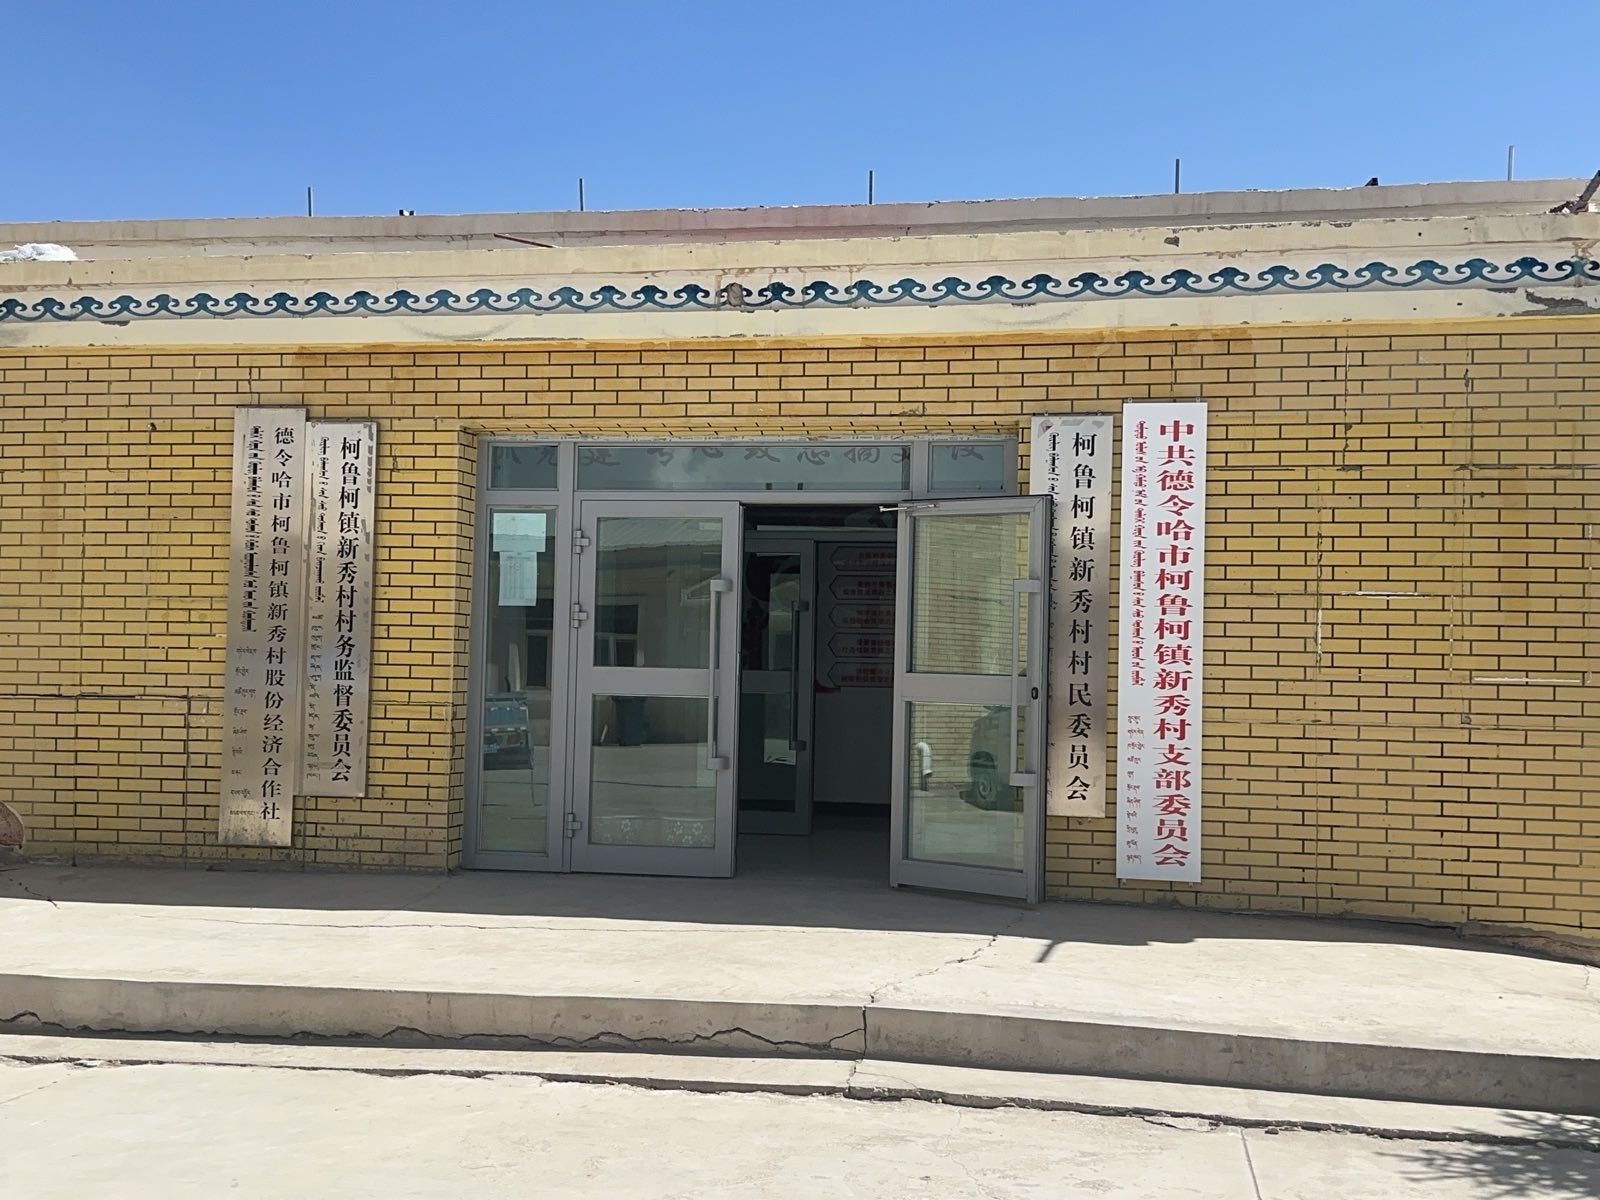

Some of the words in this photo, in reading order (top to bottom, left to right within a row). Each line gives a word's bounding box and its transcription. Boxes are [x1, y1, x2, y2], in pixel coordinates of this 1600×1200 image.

[260, 427, 295, 820] 德令哈市柯鲁柯镇新秀村股份经济合作社
[331, 436, 362, 782] 柯鲁柯镇新秀村村务监督委员会
[1066, 432, 1097, 801] 柯鲁柯镇新秀村村民委员会
[1152, 420, 1195, 867] 中共德令哈市柯鲁柯镇新秀村支部委员会
